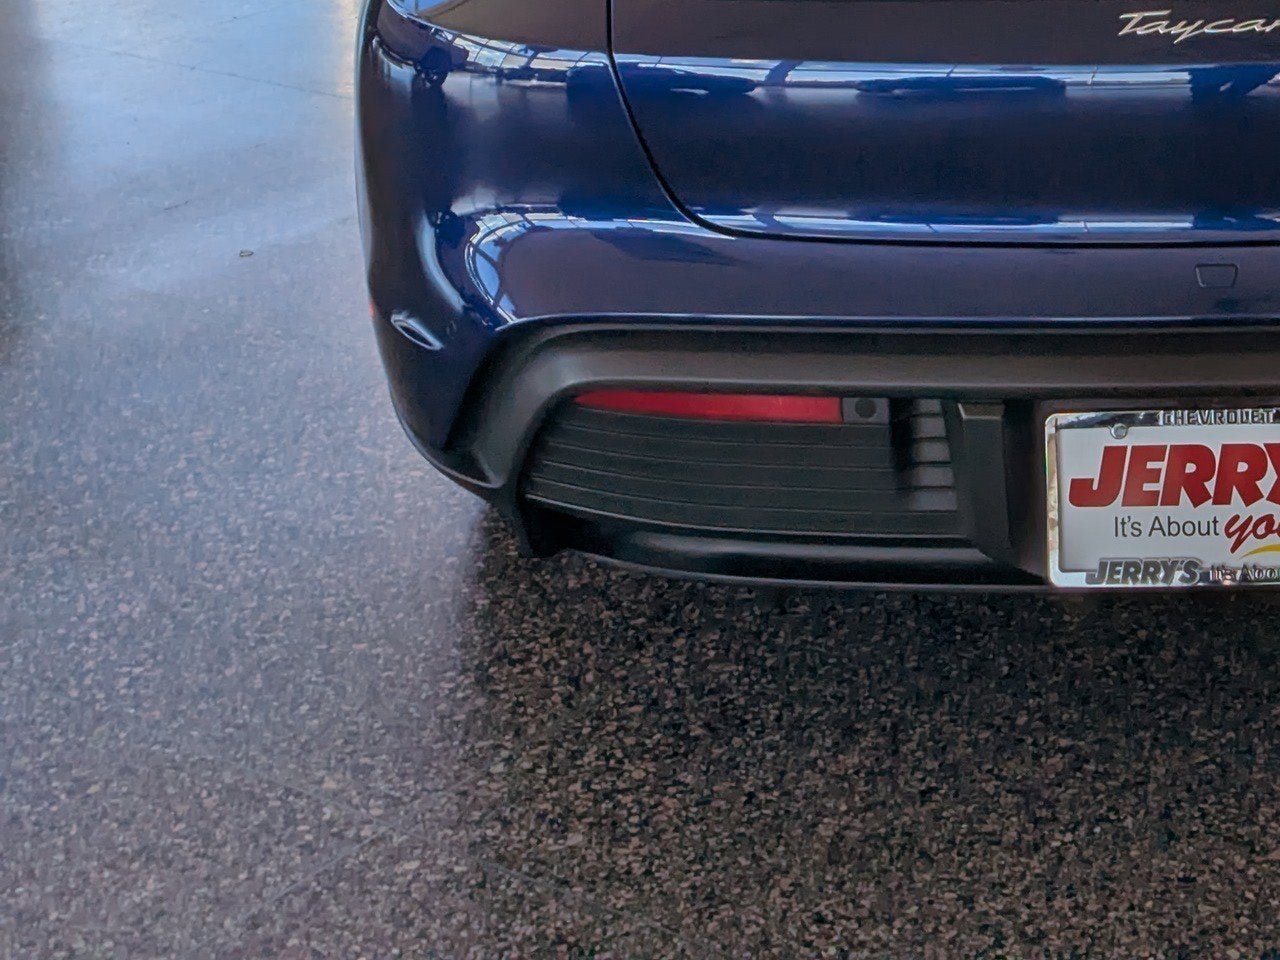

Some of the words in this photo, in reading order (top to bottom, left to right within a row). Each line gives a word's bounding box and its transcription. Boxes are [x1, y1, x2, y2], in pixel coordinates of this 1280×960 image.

[1157, 409, 1276, 426] CHEVROLET
[1114, 516, 1142, 538] It's
[1149, 515, 1220, 538] About
[1085, 556, 1203, 586] JERRY'S
[1209, 563, 1234, 582] It's
